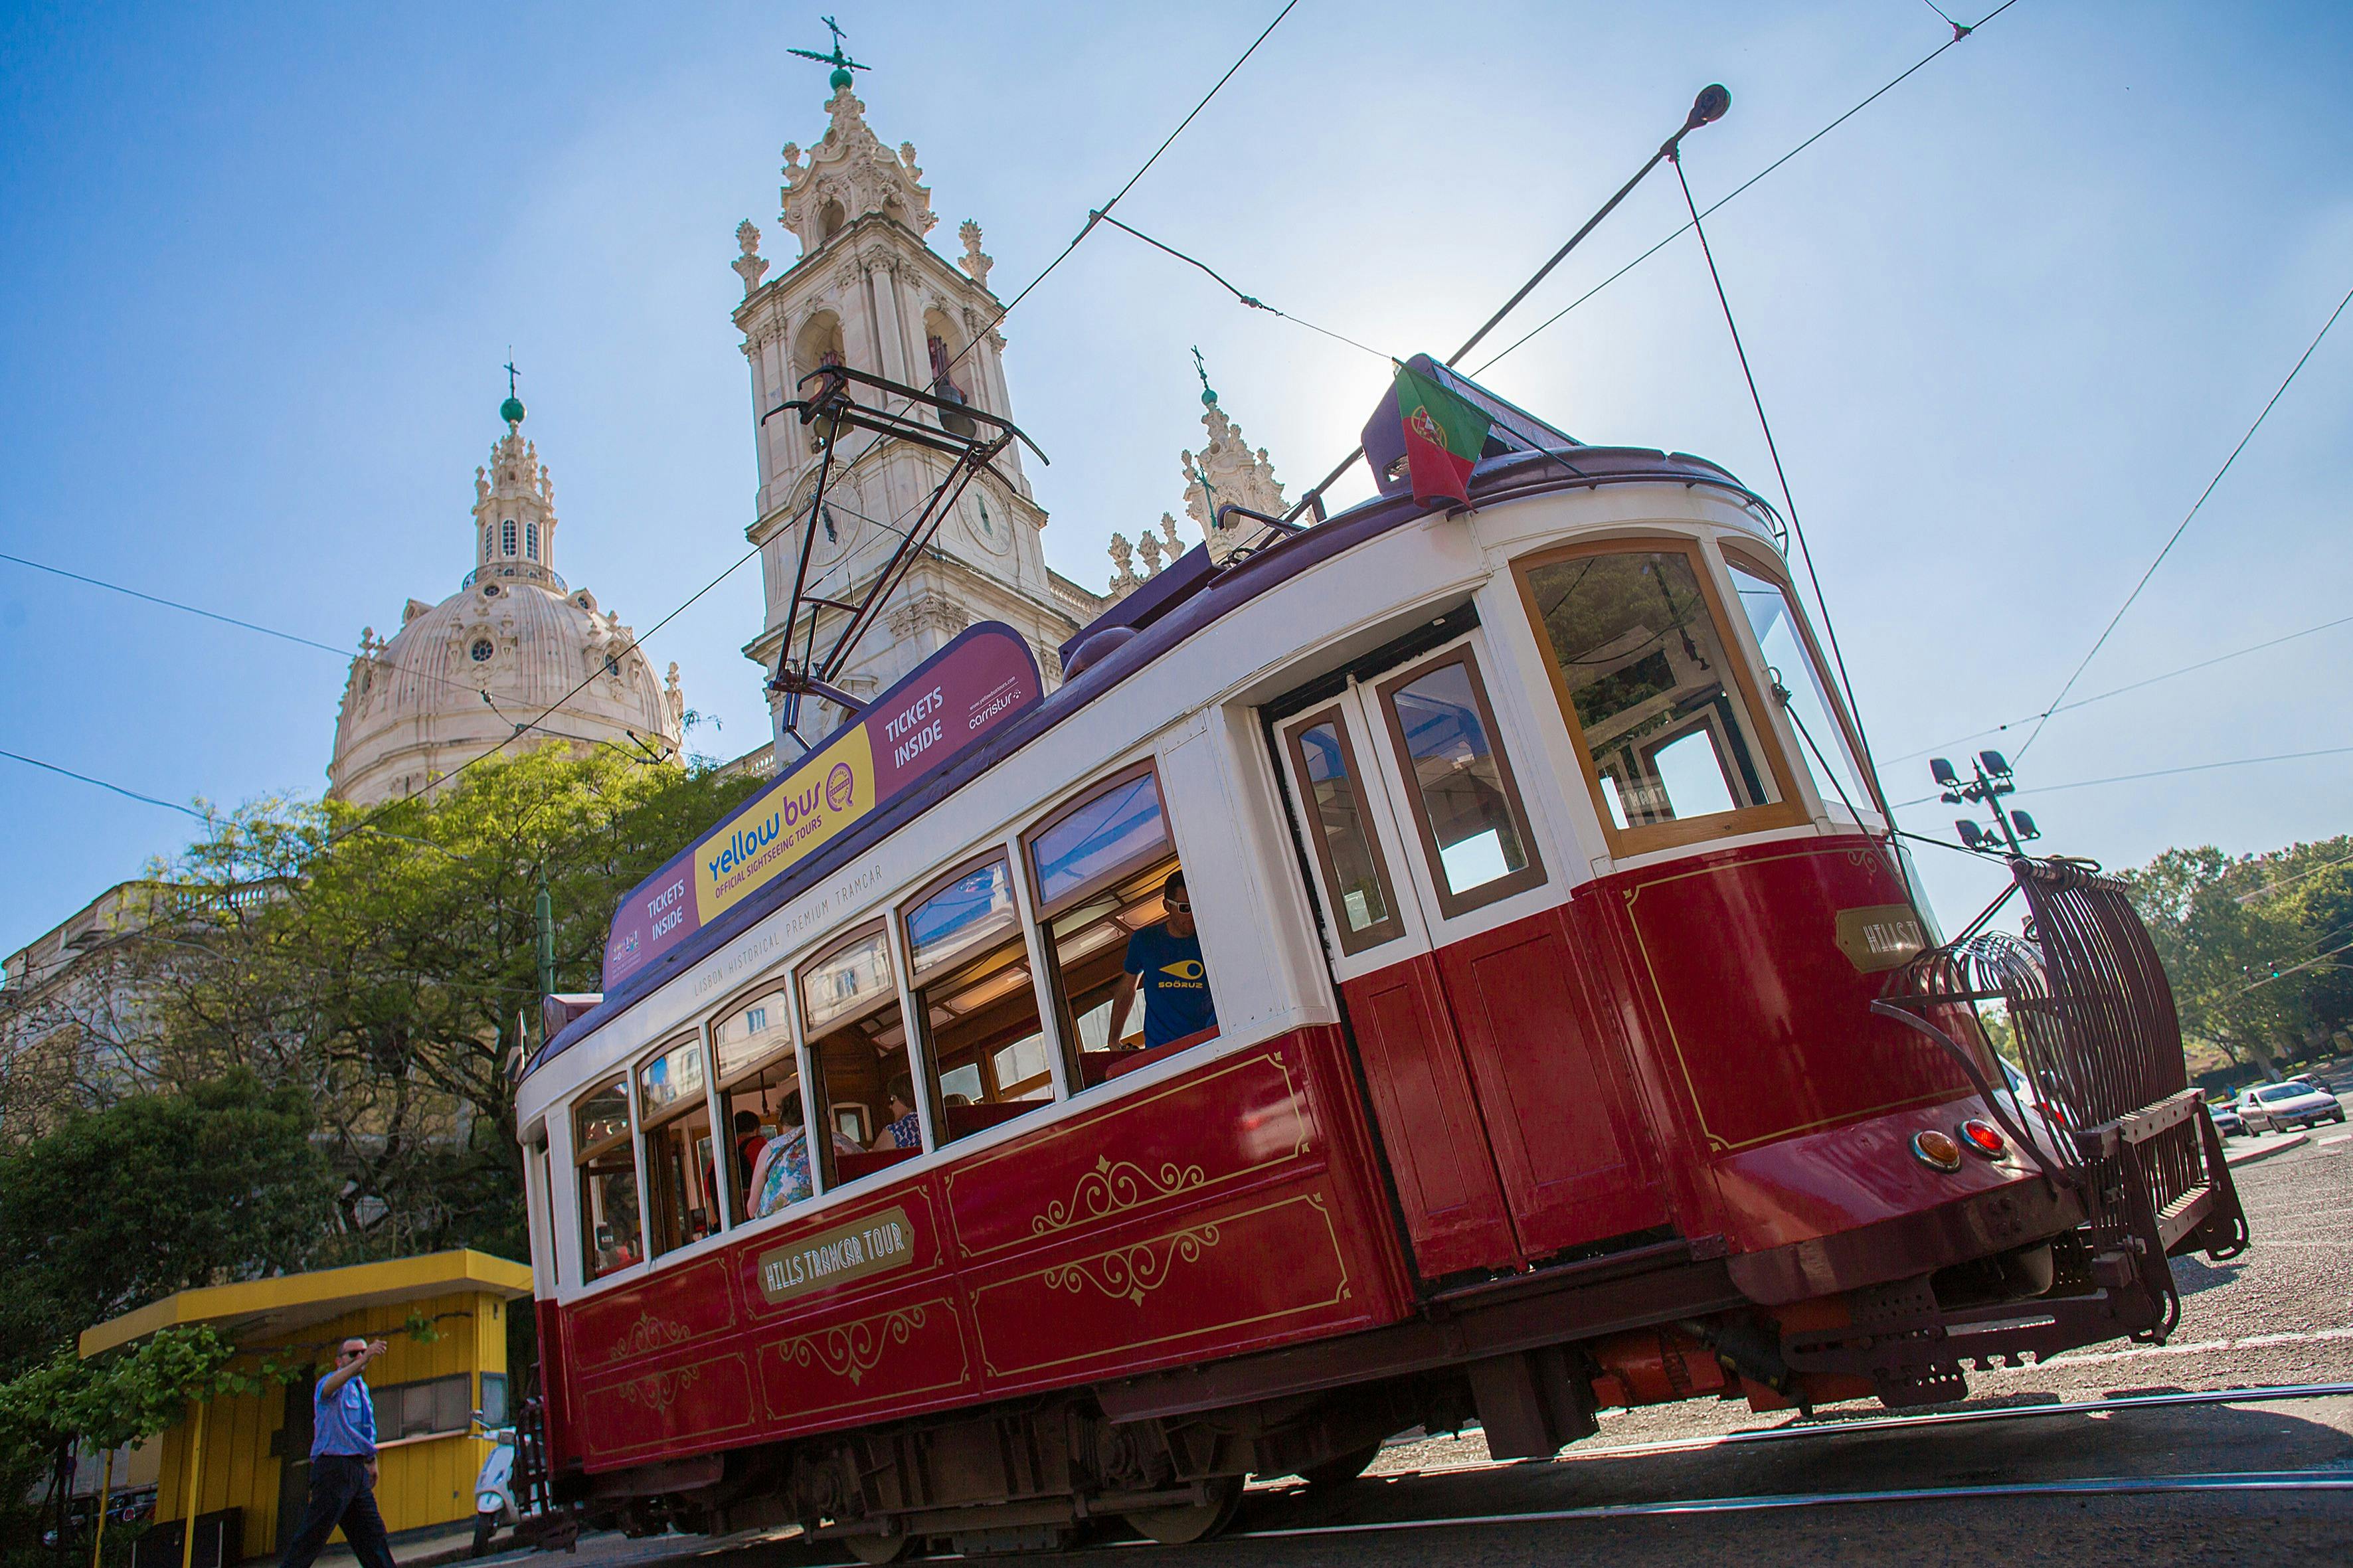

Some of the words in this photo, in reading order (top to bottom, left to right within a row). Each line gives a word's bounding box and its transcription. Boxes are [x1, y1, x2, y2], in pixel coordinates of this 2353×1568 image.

[885, 685, 944, 742] TICKETS
[969, 692, 1012, 729] carristur
[894, 718, 943, 769] INSIDE
[709, 812, 780, 882] yellow
[783, 780, 821, 826] bus
[715, 870, 746, 899] OFFICIAL
[746, 834, 794, 877] SIGHTSEEING
[795, 814, 822, 842] TOURS
[647, 878, 685, 919] TICKETS
[652, 905, 683, 942] INSIDE
[694, 967, 723, 997] LISBON
[728, 932, 780, 974] HISTORICAL
[786, 899, 829, 938] PREMIUM
[835, 865, 883, 906] TRAMCAR
[1862, 921, 1911, 954] HILLS
[764, 1255, 804, 1292] HILLS
[803, 1236, 865, 1280] TRAMCAR
[863, 1222, 905, 1261] TOUR
